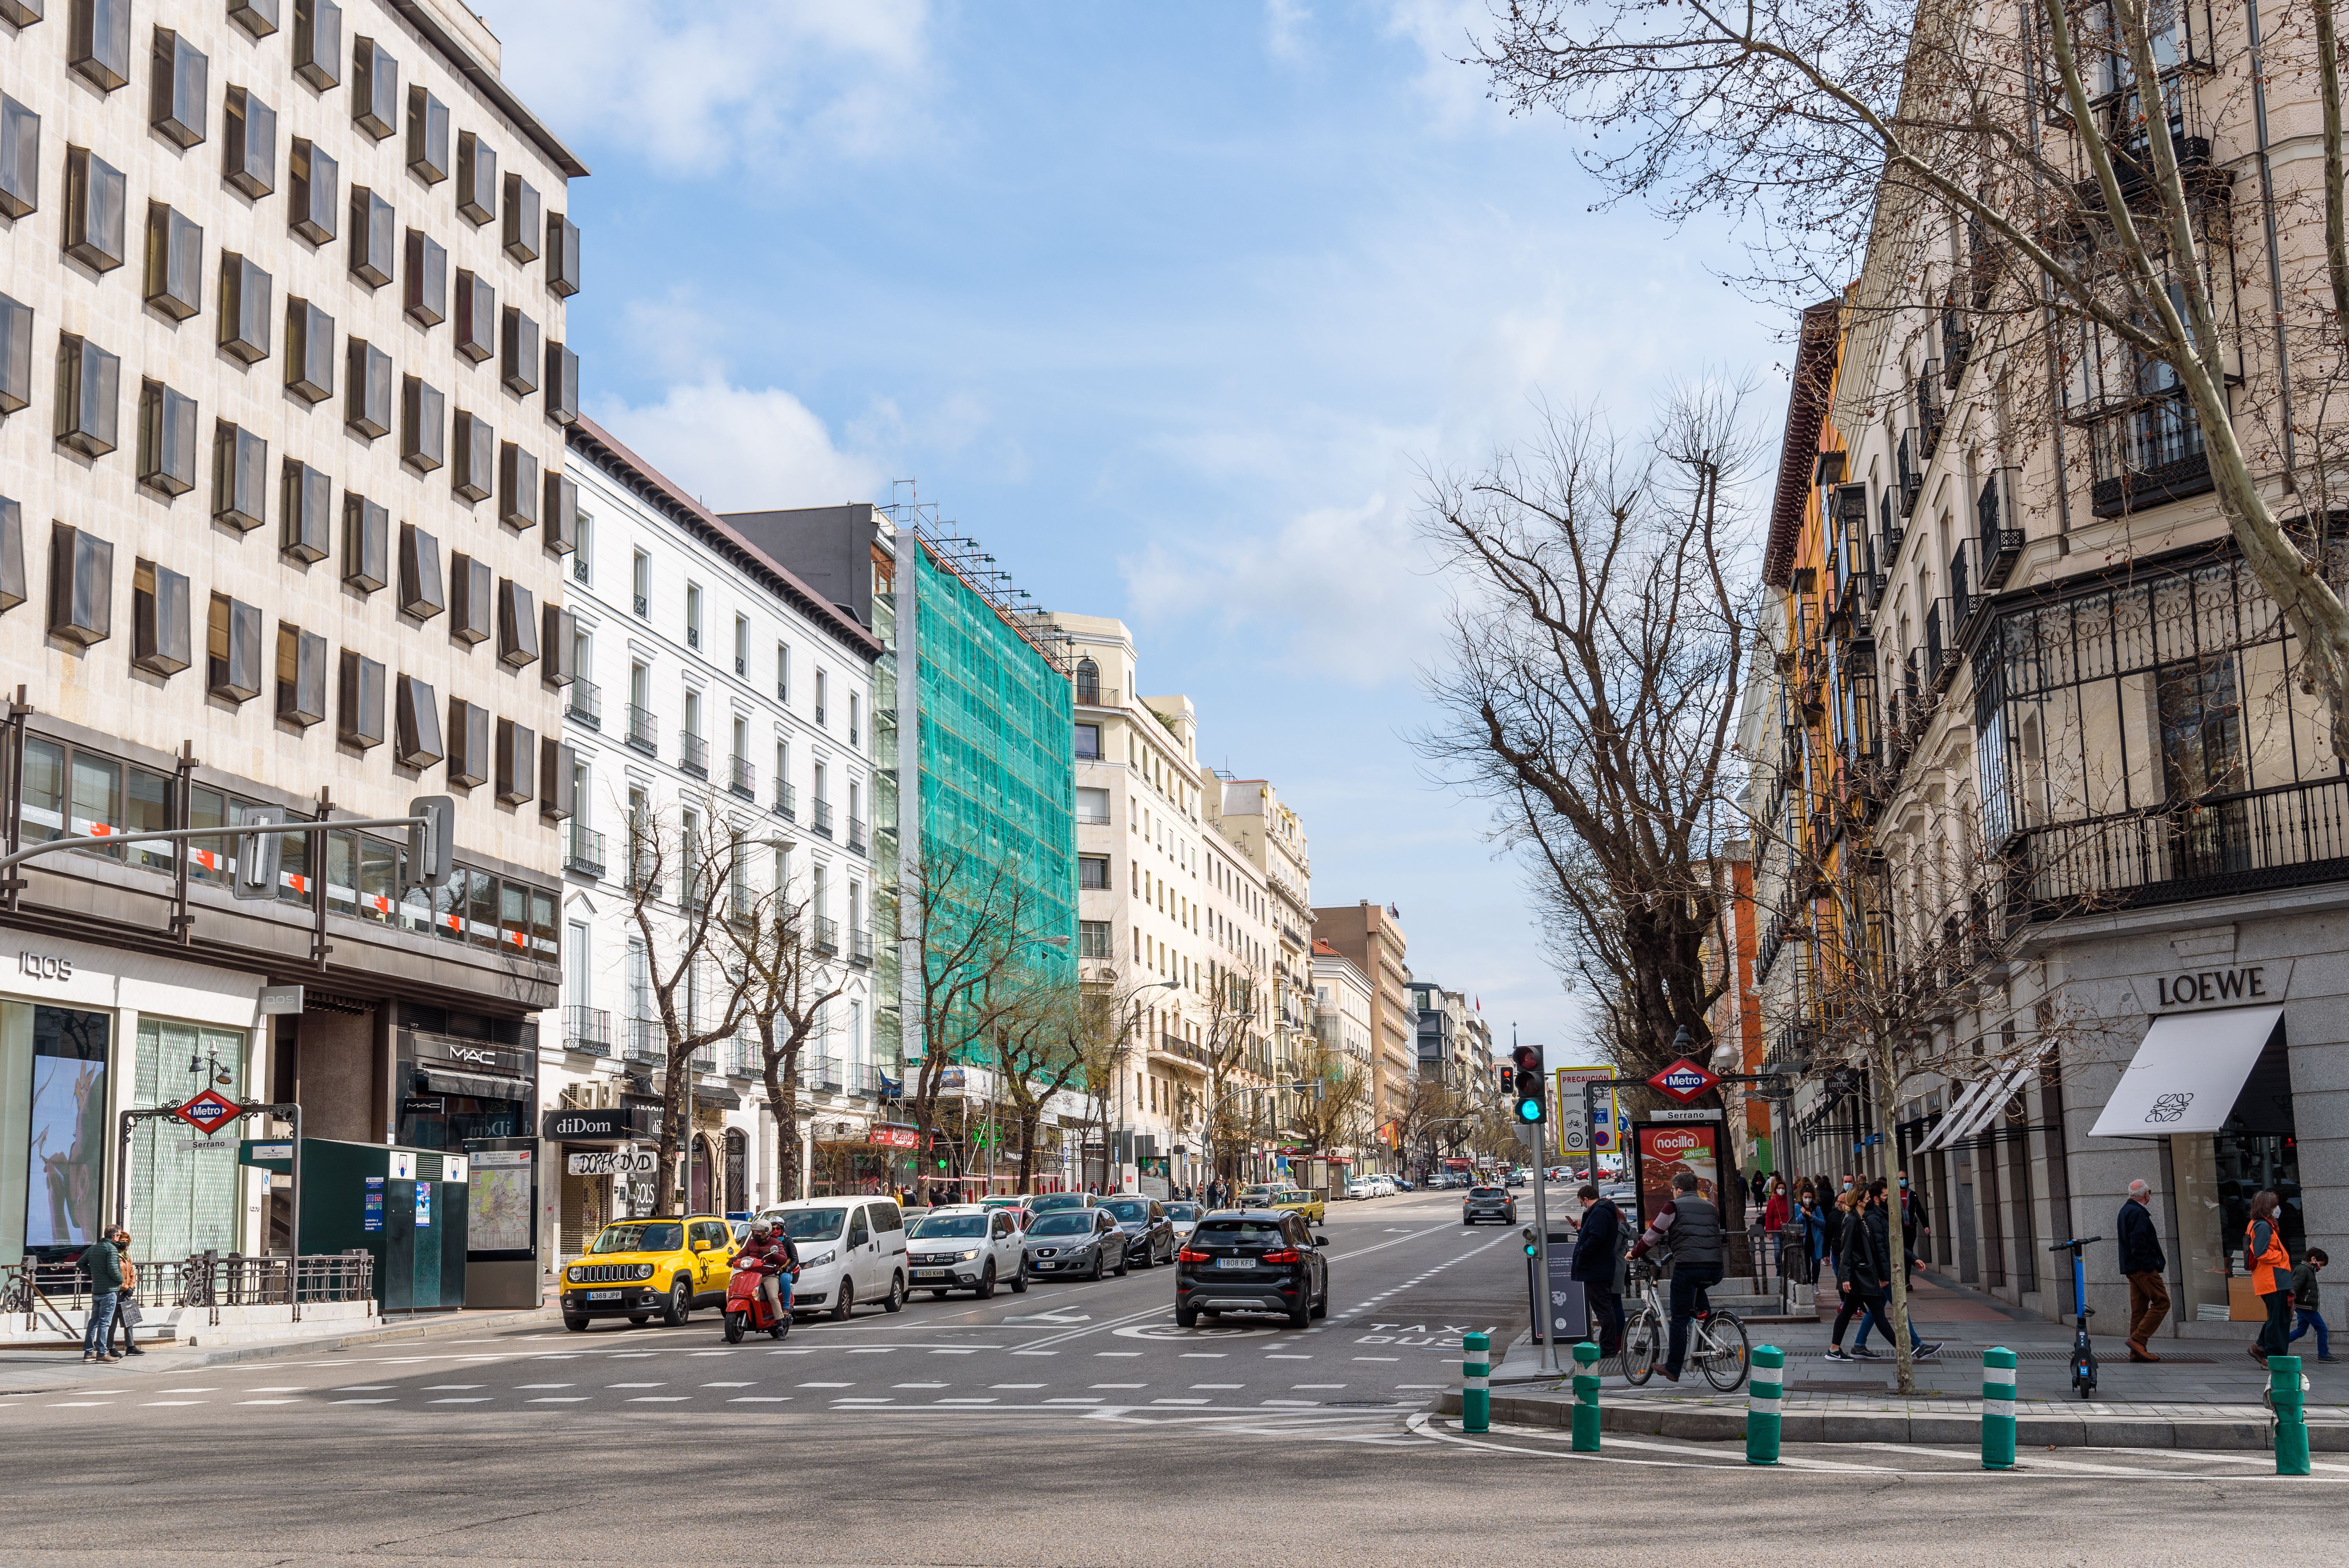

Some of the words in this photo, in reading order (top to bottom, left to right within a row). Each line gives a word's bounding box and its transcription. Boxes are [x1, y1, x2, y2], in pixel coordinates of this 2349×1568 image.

[20, 951, 73, 981] IQOS
[2157, 967, 2266, 1005] LOEWE
[262, 994, 294, 1005] IQOS
[1563, 1074, 1608, 1083] PRECAUCIÓN
[1669, 1076, 1700, 1085] Metro
[193, 1107, 221, 1115] Metro
[557, 1118, 611, 1133] diDom
[1657, 1136, 1695, 1148] nocilla
[1683, 1149, 1696, 1158] SIN
[620, 1153, 651, 1171] DVD
[1370, 1323, 1497, 1334] TAXI
[1353, 1335, 1463, 1347] BUS
